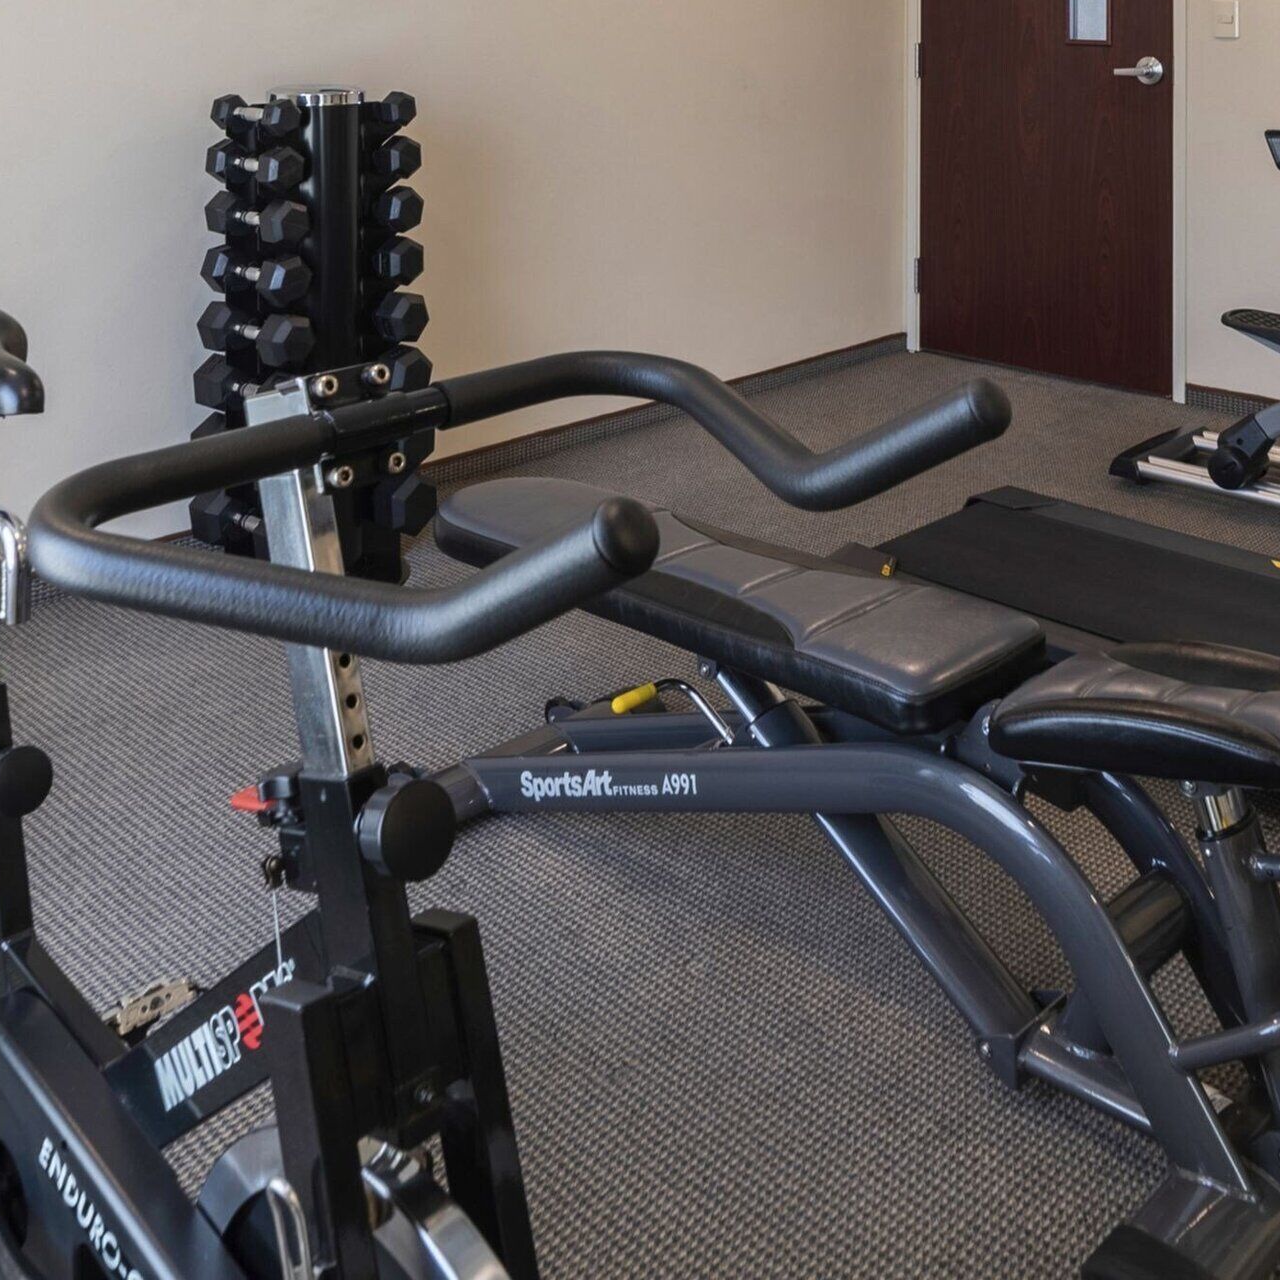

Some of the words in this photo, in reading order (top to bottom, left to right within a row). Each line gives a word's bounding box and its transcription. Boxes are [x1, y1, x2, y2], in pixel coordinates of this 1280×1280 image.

[520, 769, 613, 801] SportsArt
[612, 784, 659, 796] FITNESS
[661, 773, 698, 795] A991
